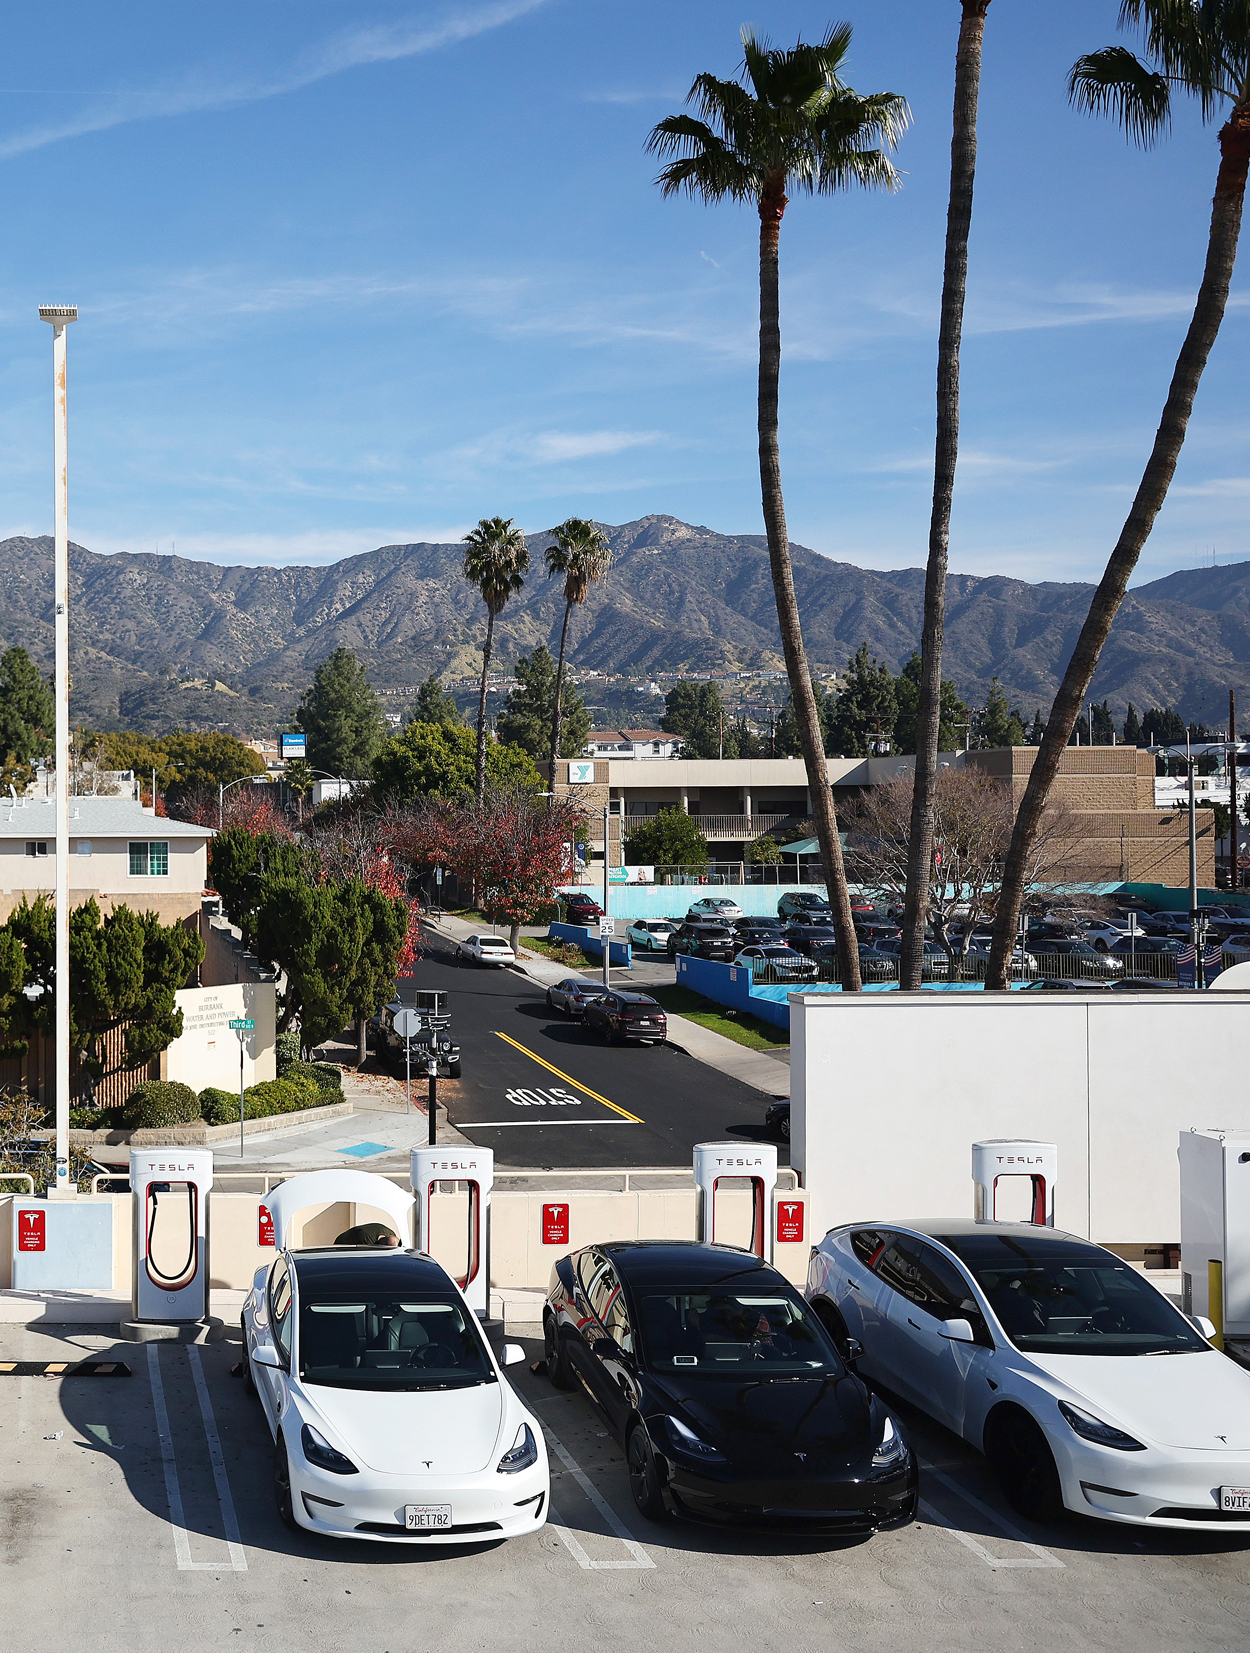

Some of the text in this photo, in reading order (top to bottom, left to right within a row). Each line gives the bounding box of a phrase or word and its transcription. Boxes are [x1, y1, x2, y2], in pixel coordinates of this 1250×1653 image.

[198, 1003, 224, 1012] BURBANK
[186, 1011, 236, 1023] WATER AND POWER
[230, 1020, 246, 1028] Third
[505, 1088, 581, 1106] STOP
[148, 1163, 194, 1171] TESLA
[430, 1161, 476, 1169] TESLA
[408, 1514, 448, 1526] 9DET782
